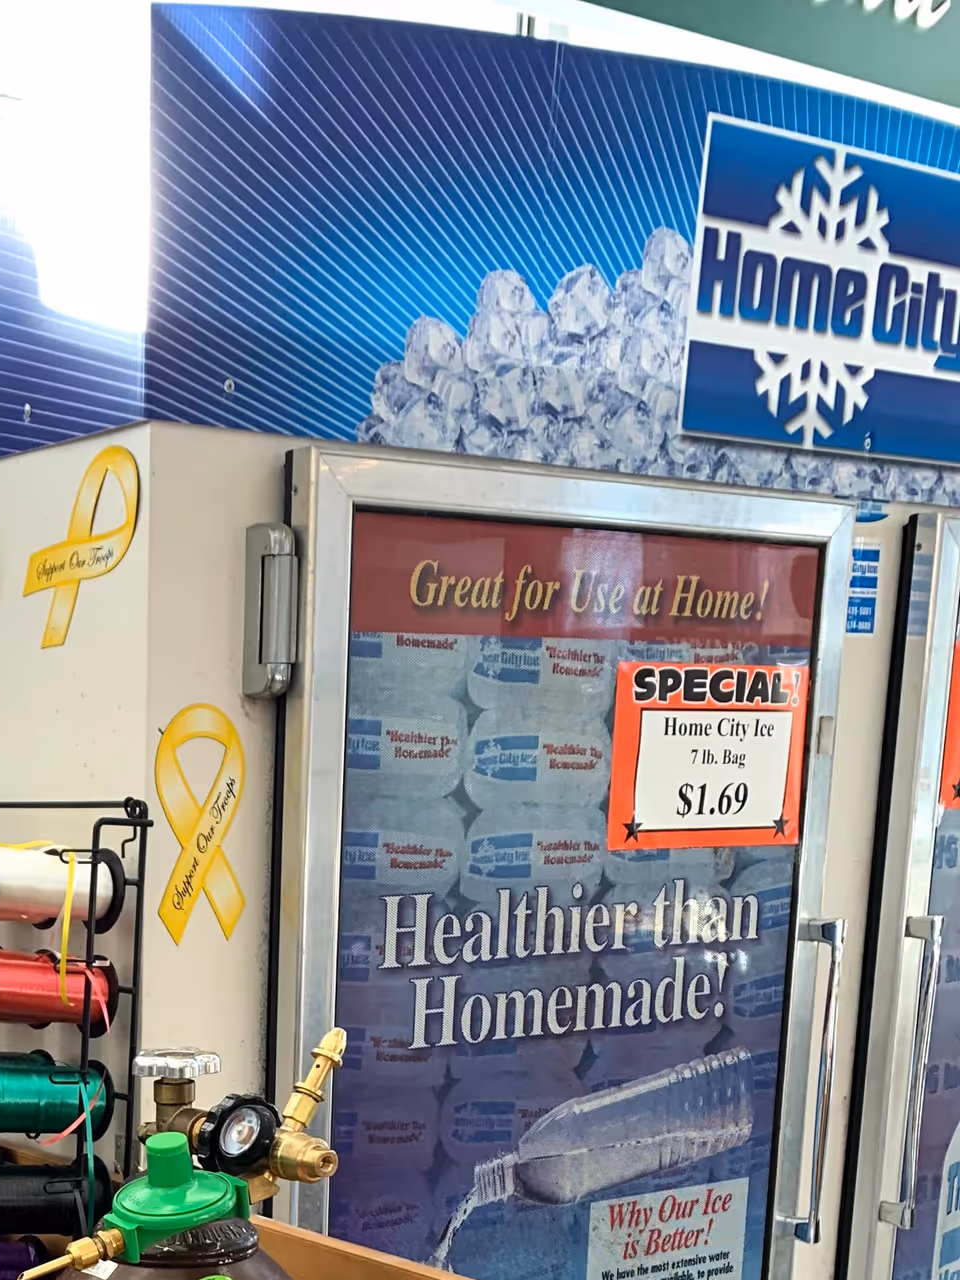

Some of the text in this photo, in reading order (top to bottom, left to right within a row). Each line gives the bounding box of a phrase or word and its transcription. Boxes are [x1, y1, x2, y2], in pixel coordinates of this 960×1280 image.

[697, 225, 960, 370] Home City
[36, 546, 114, 582] Support Our Troops
[410, 559, 770, 621] Great for Use at Home!
[633, 667, 800, 706] SPECIAL!
[664, 717, 774, 742] Home City Ice
[690, 749, 746, 769] 7 lb. Bag
[676, 782, 748, 818] $1.69
[172, 777, 236, 911] Support Our Troops
[378, 878, 759, 971] Healthier than
[407, 952, 728, 1050] Homemade!
[609, 1188, 733, 1234] Why Our Ice
[623, 1217, 714, 1260] is Better!
[617, 1267, 635, 1279] have
[637, 1264, 648, 1275] the
[651, 1261, 669, 1273] most
[671, 1254, 707, 1270] extensive
[708, 1250, 730, 1263] water
[697, 1269, 705, 1279] to
[707, 1263, 733, 1279] provide
